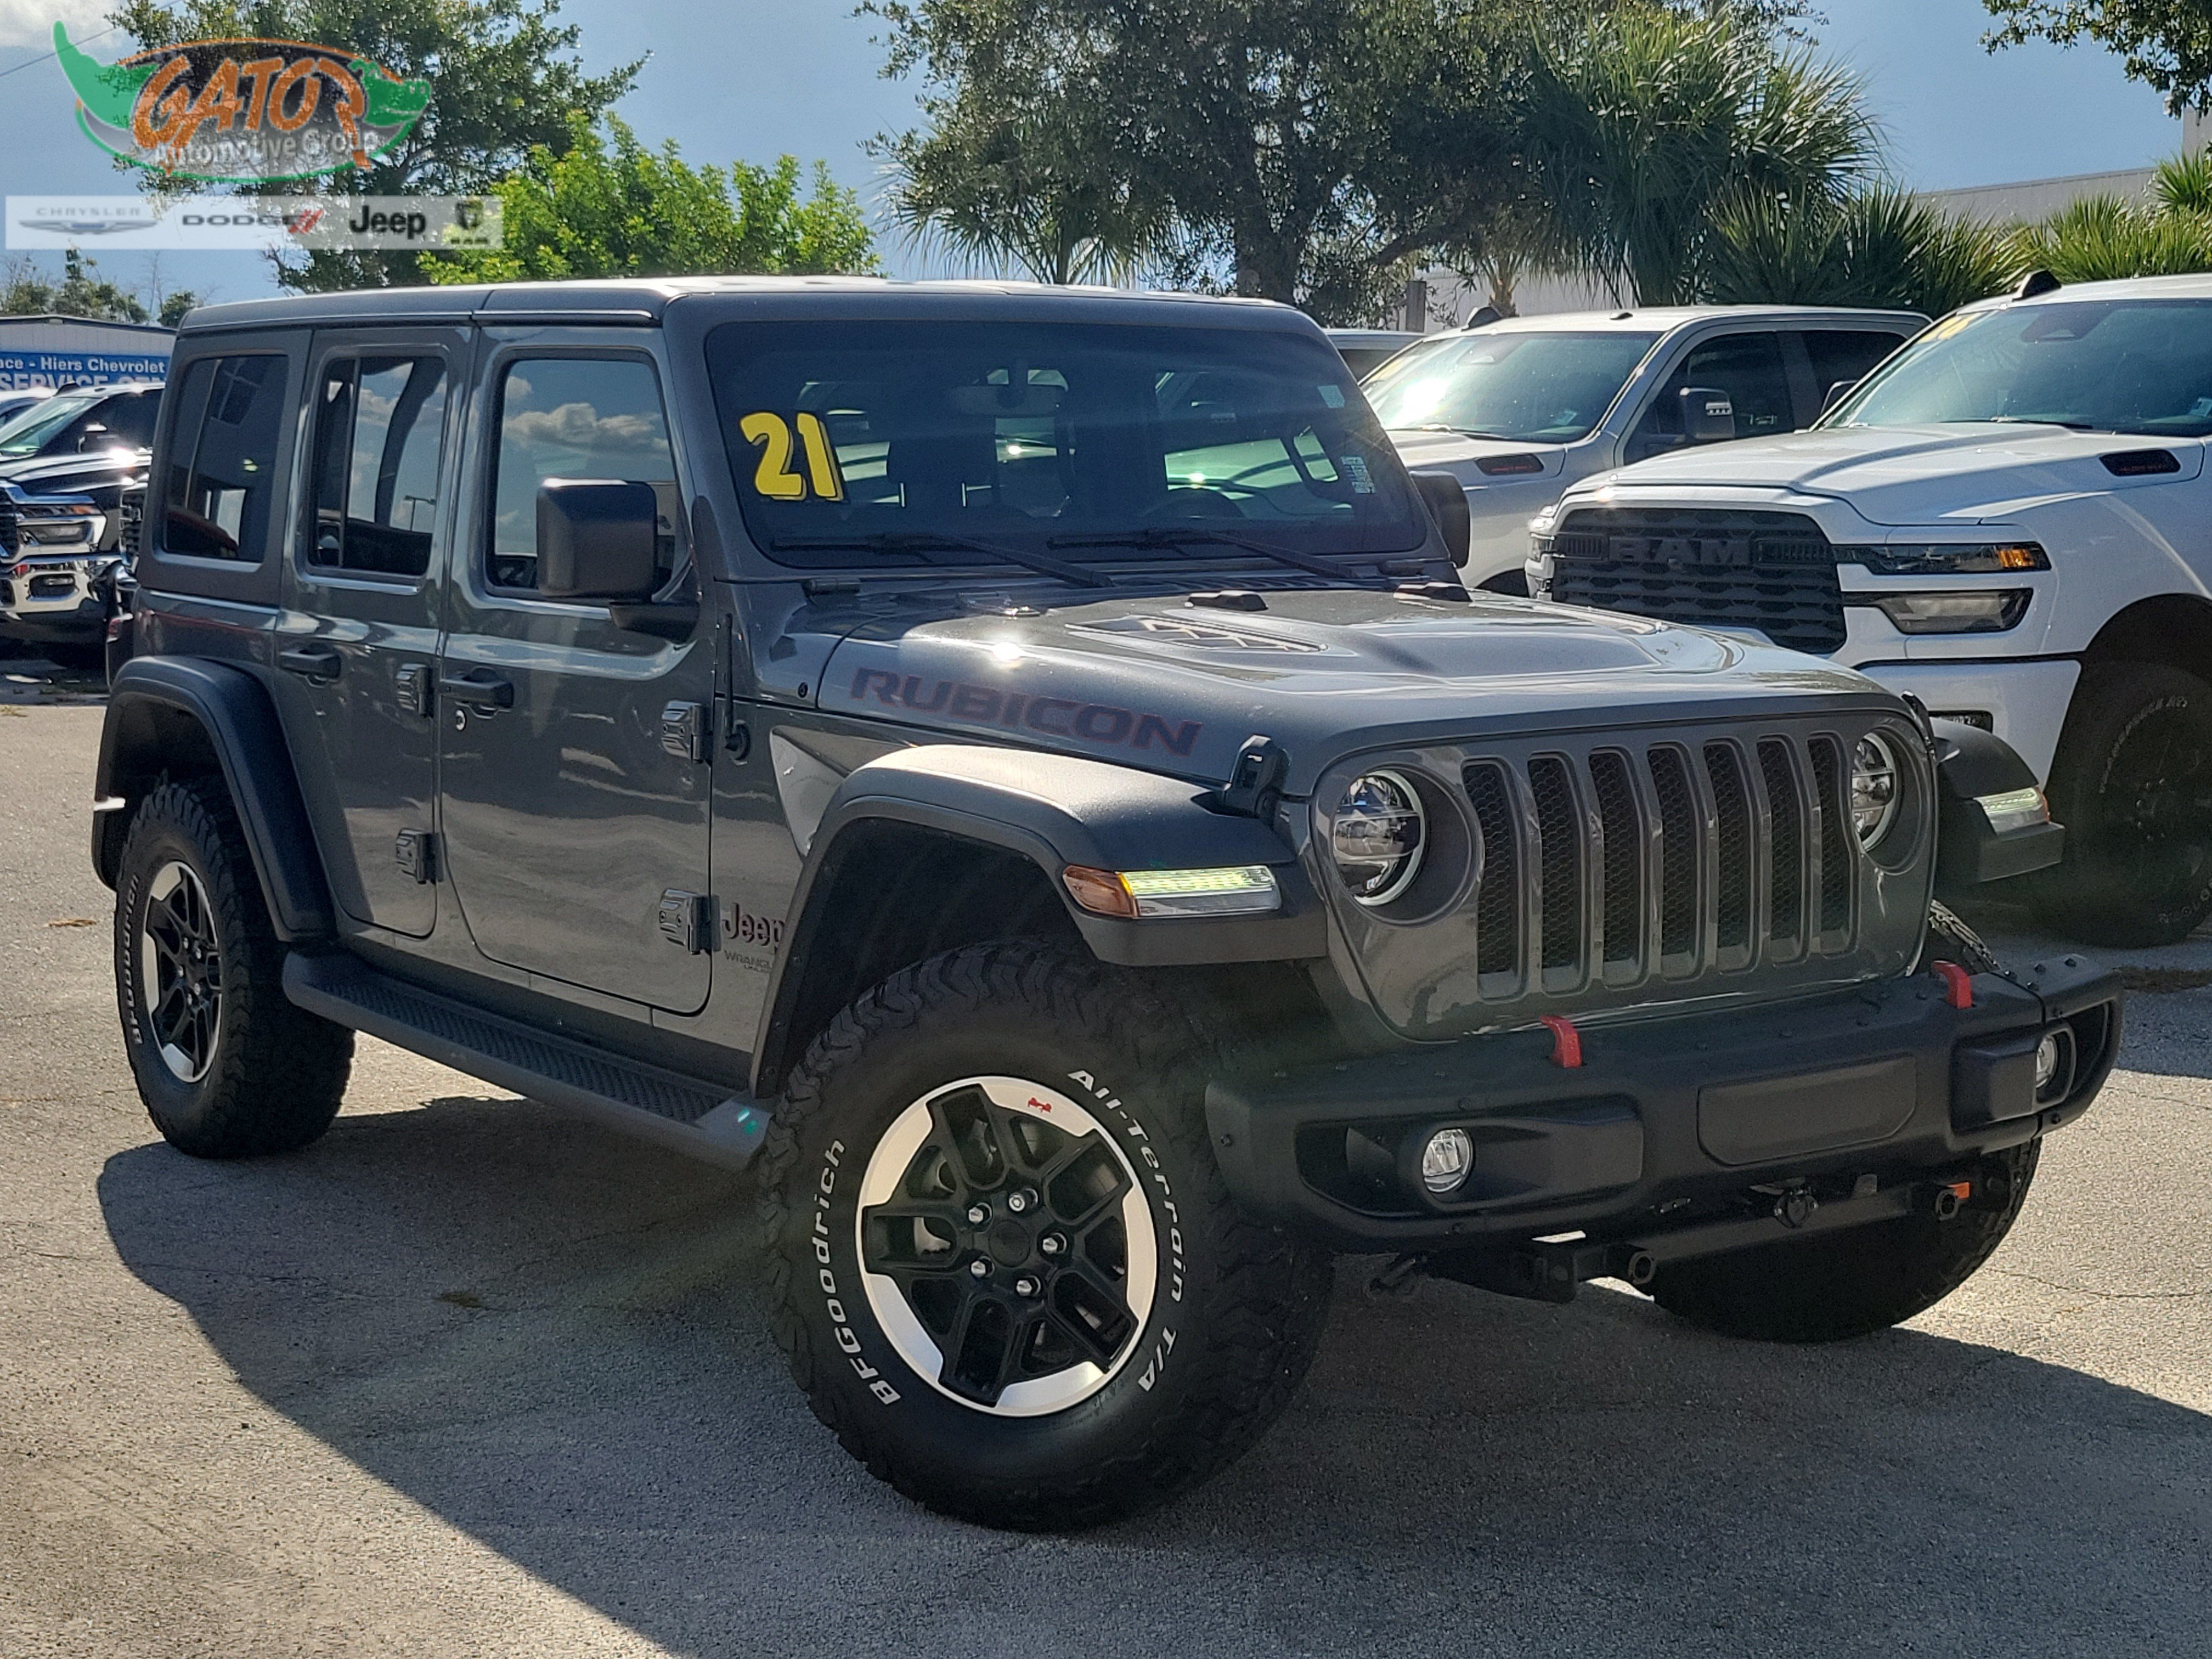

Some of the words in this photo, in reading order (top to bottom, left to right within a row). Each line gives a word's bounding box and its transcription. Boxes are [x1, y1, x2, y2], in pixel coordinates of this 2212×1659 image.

[41, 356, 82, 372] Hiers
[88, 358, 165, 373] Chevrolet
[740, 411, 844, 501] 21
[850, 666, 1204, 757] RUBICON
[720, 902, 785, 954] Jeep
[812, 1140, 901, 1406] BFGoodrich
[1068, 1070, 1186, 1302] All-Terrain
[1138, 1327, 1176, 1392] T/A
